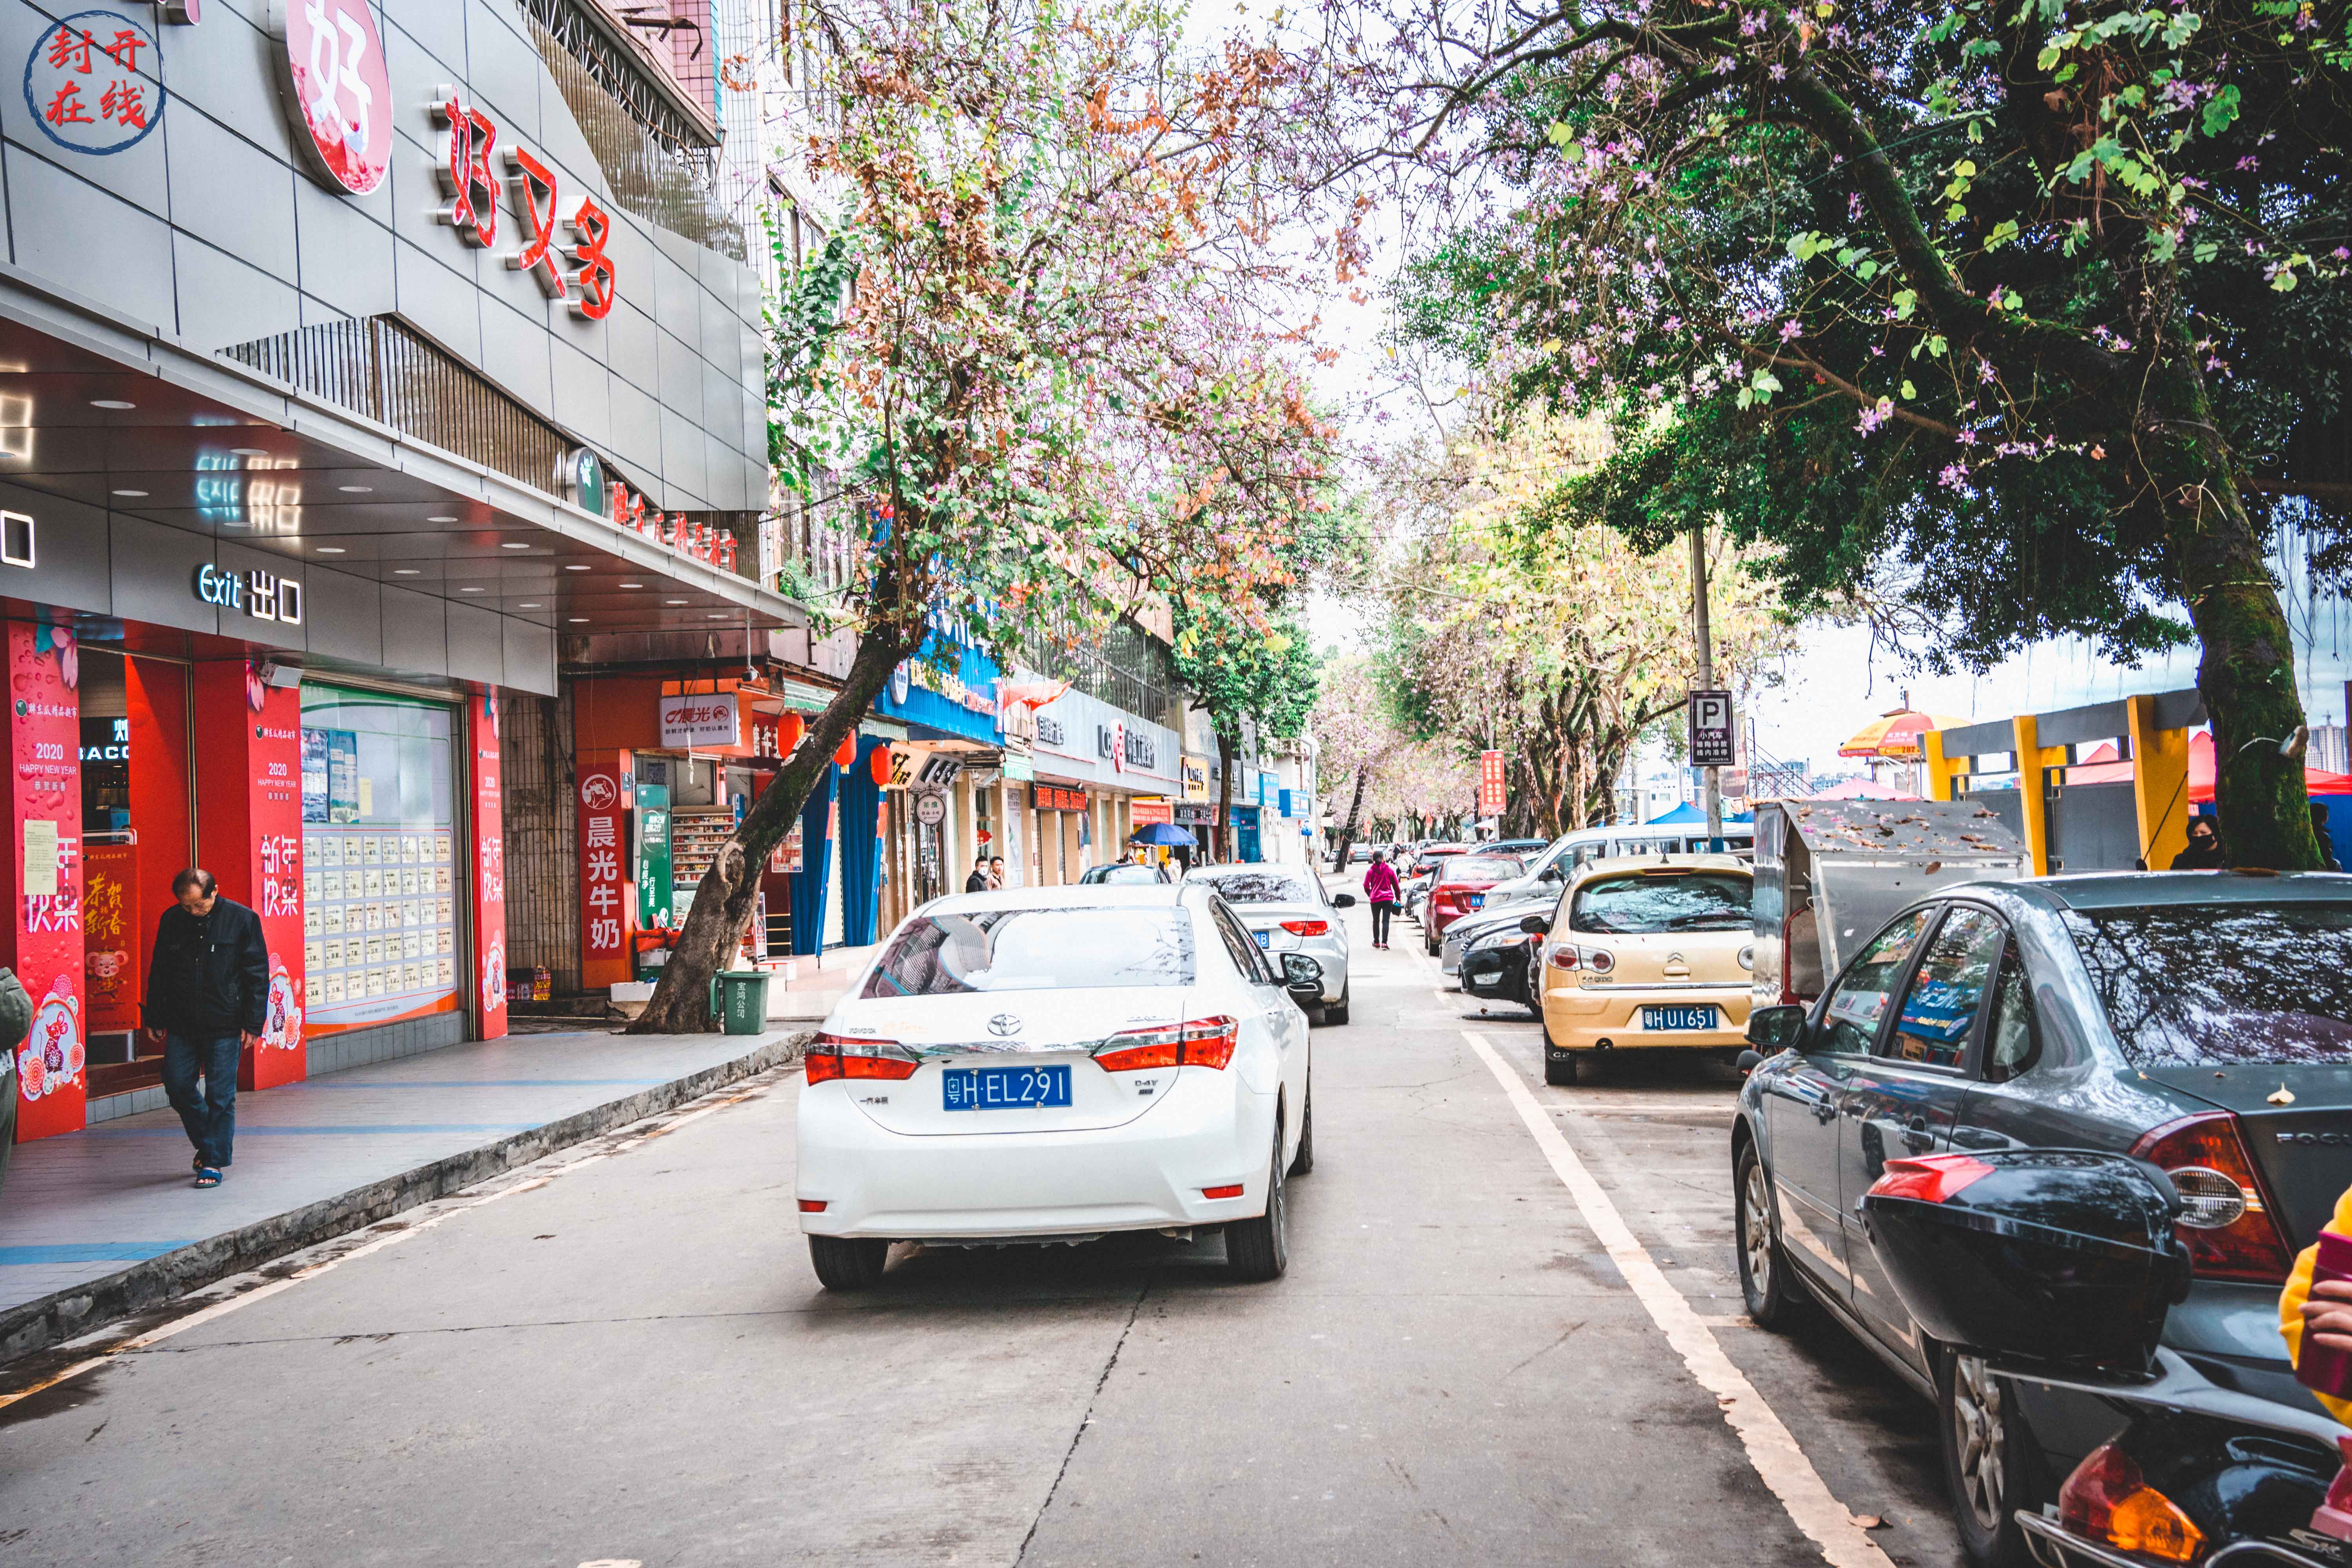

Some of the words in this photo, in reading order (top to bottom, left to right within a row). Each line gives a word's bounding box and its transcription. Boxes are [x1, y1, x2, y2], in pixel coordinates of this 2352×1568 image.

[444, 83, 615, 320] 好又多
[198, 564, 243, 609] Exit
[250, 570, 301, 625] 出口
[1703, 701, 1719, 725] P
[36, 743, 63, 760] 2020
[1700, 731, 1723, 740] 小汽车
[20, 764, 44, 773] HAPPY
[45, 765, 59, 774] NEW
[61, 766, 77, 775] YEAR
[269, 762, 287, 776] 2020
[485, 777, 495, 788] 2020
[57, 837, 77, 880] 年
[261, 834, 297, 874] 新年
[481, 835, 501, 867] 新年
[587, 817, 619, 950] 晨光牛奶
[737, 981, 746, 1018] 宝鸿公司
